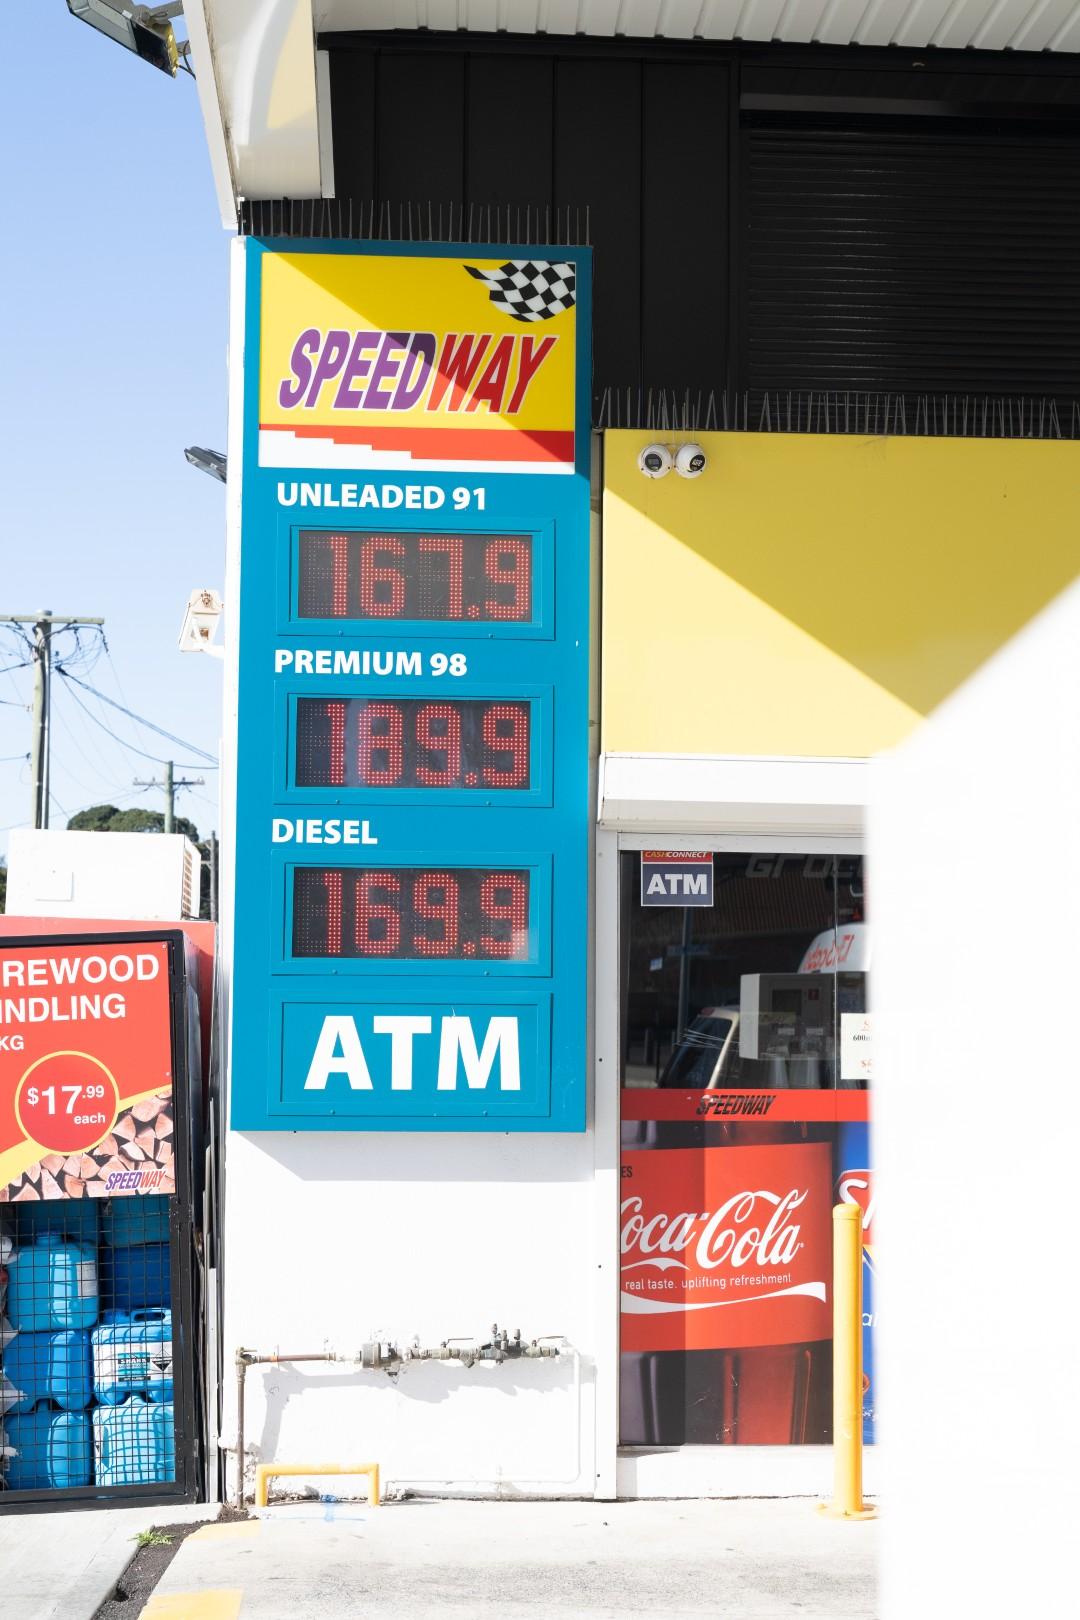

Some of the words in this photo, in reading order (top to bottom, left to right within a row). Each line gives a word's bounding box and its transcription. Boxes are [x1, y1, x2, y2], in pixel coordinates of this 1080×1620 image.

[278, 328, 560, 415] SPEEDWAY
[277, 482, 445, 510] UNLEADED
[453, 486, 486, 510] 91
[330, 536, 530, 620] 167.9
[274, 649, 423, 676] PREMIUM
[430, 652, 468, 677] 98
[326, 703, 529, 786] 189.9
[271, 818, 378, 845] DIESEL
[646, 873, 708, 895] ATM
[324, 872, 526, 956] 169.9
[2, 954, 160, 988] REWOOD
[303, 1015, 521, 1091] ATM
[74, 1111, 106, 1125] each
[696, 1094, 777, 1115] SPEEDWAY
[105, 1170, 166, 1191] SPEEDWAY
[625, 1278, 645, 1291] real
[647, 1277, 678, 1290] taste.
[681, 1275, 726, 1291] uplifting
[729, 1273, 792, 1287] refreshment
